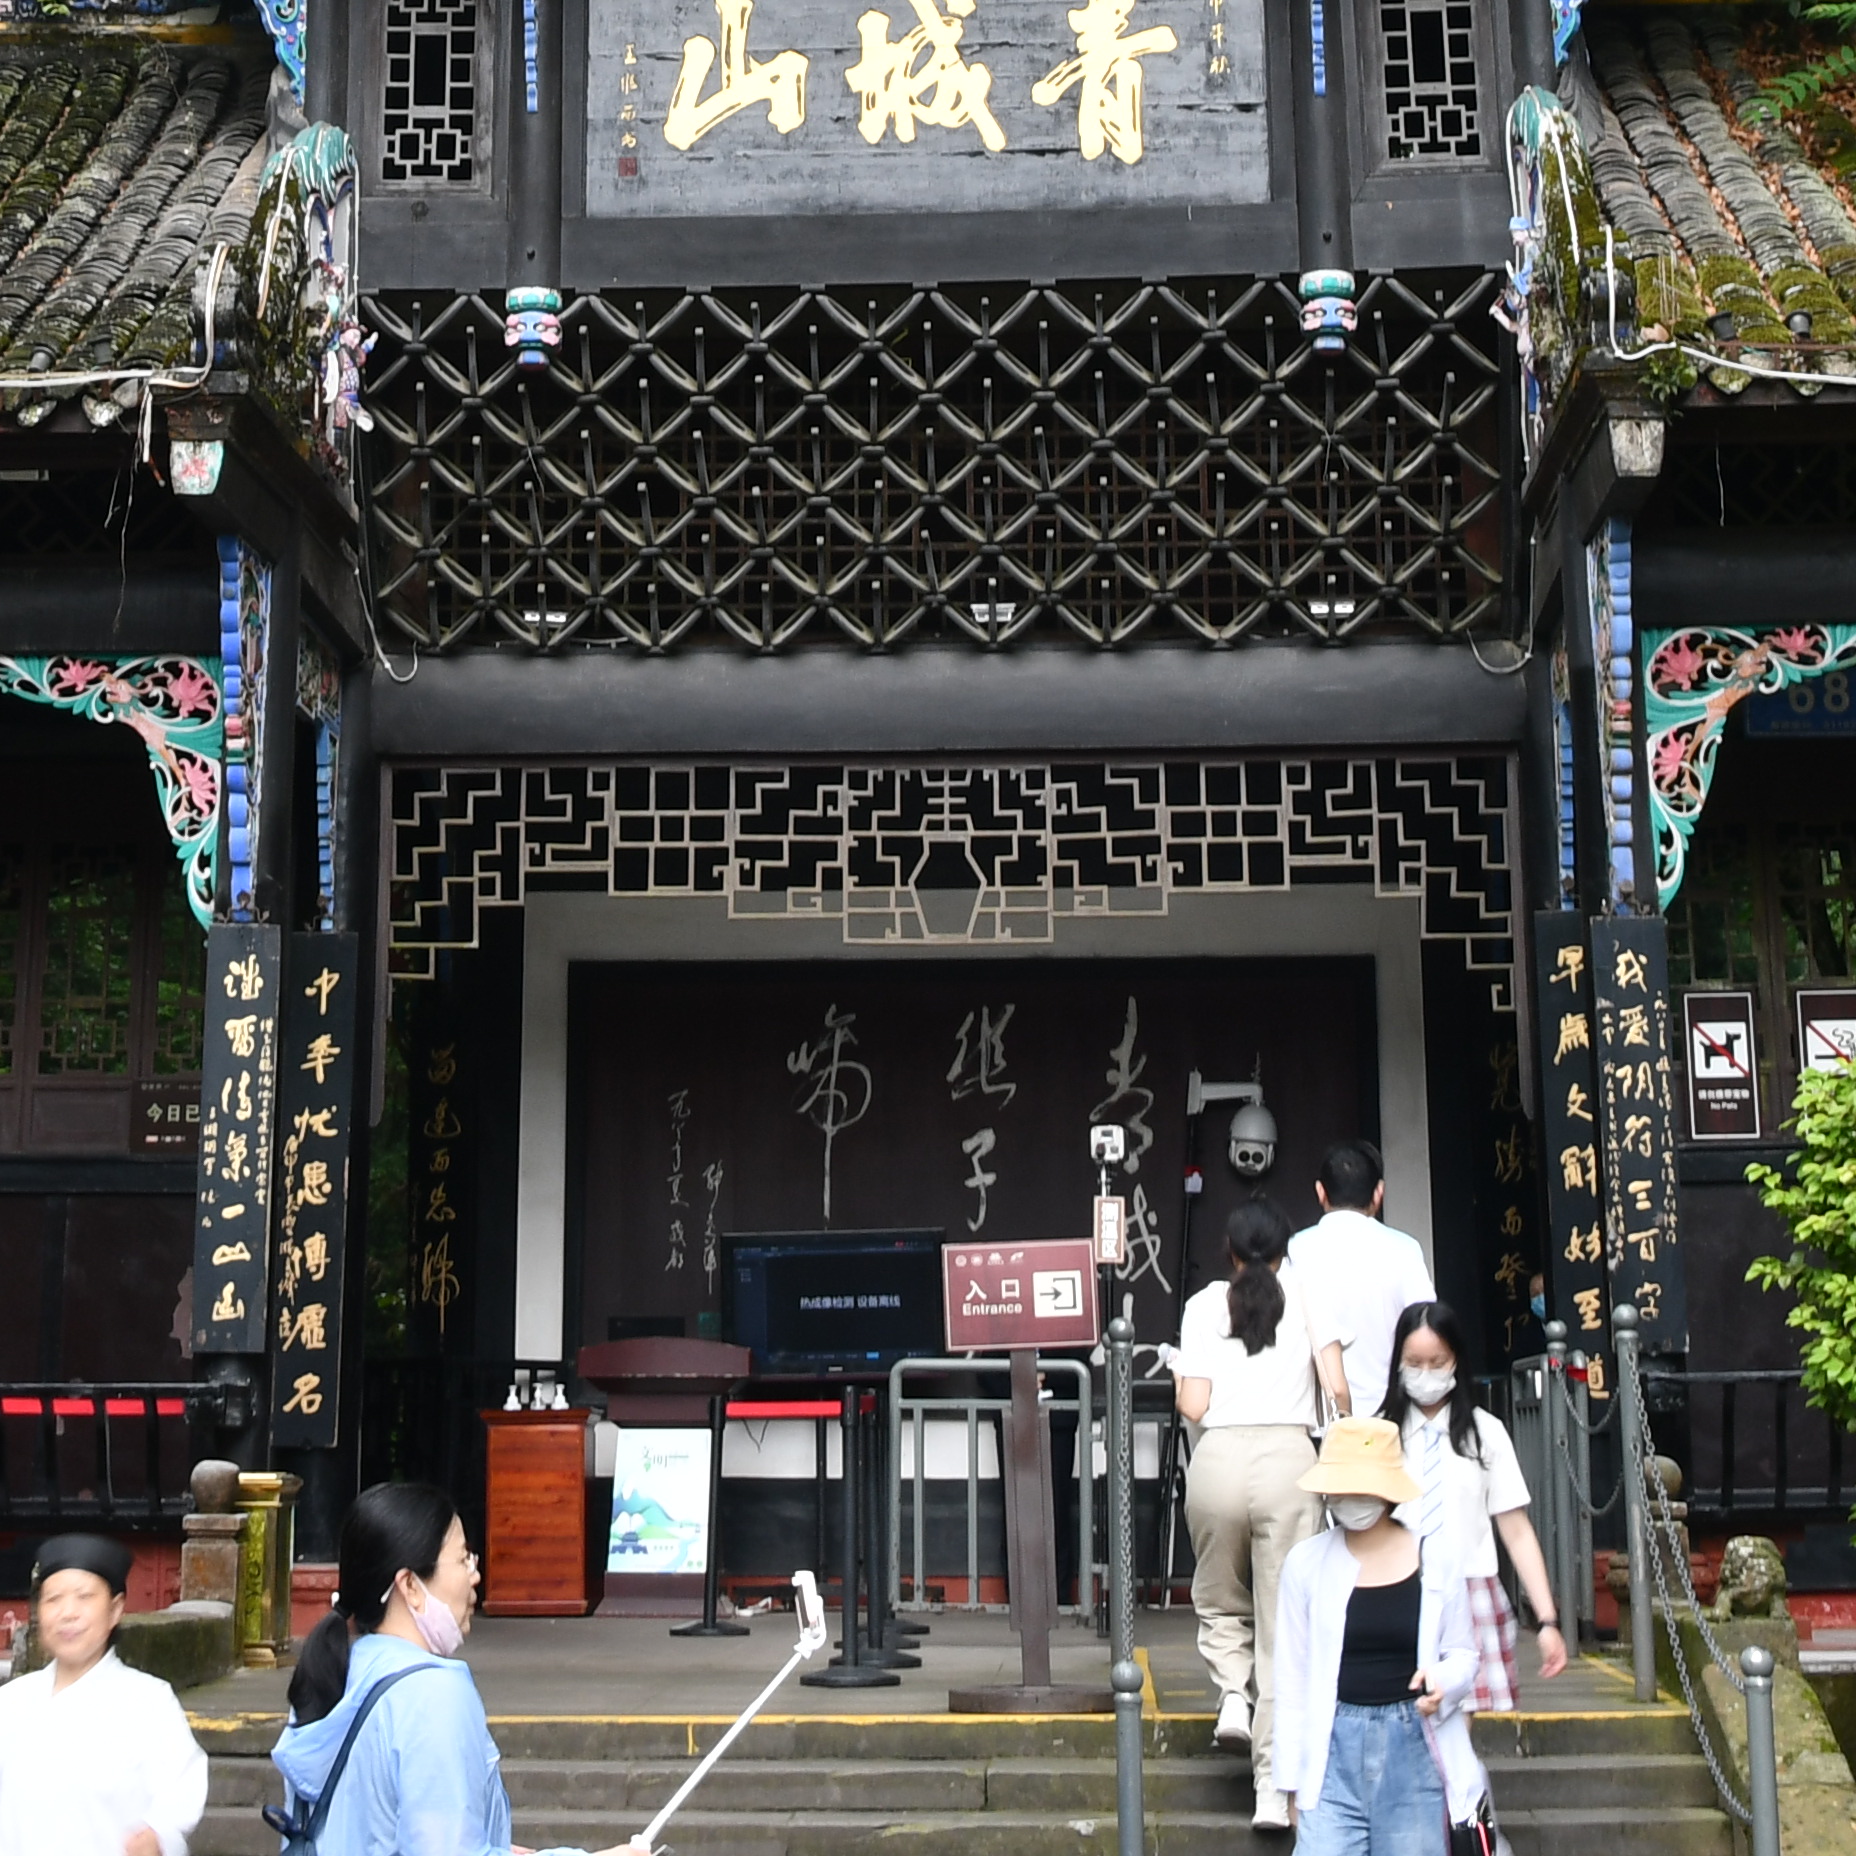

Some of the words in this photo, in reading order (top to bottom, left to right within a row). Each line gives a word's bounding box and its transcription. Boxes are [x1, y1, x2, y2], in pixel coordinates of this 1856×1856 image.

[1788, 672, 1850, 714] 68
[1710, 1101, 1721, 1110] No
[1721, 1101, 1738, 1110] Pets
[965, 1278, 1020, 1301] 入口
[857, 1295, 901, 1308] 设备离线
[962, 1302, 1023, 1317] Entrance
